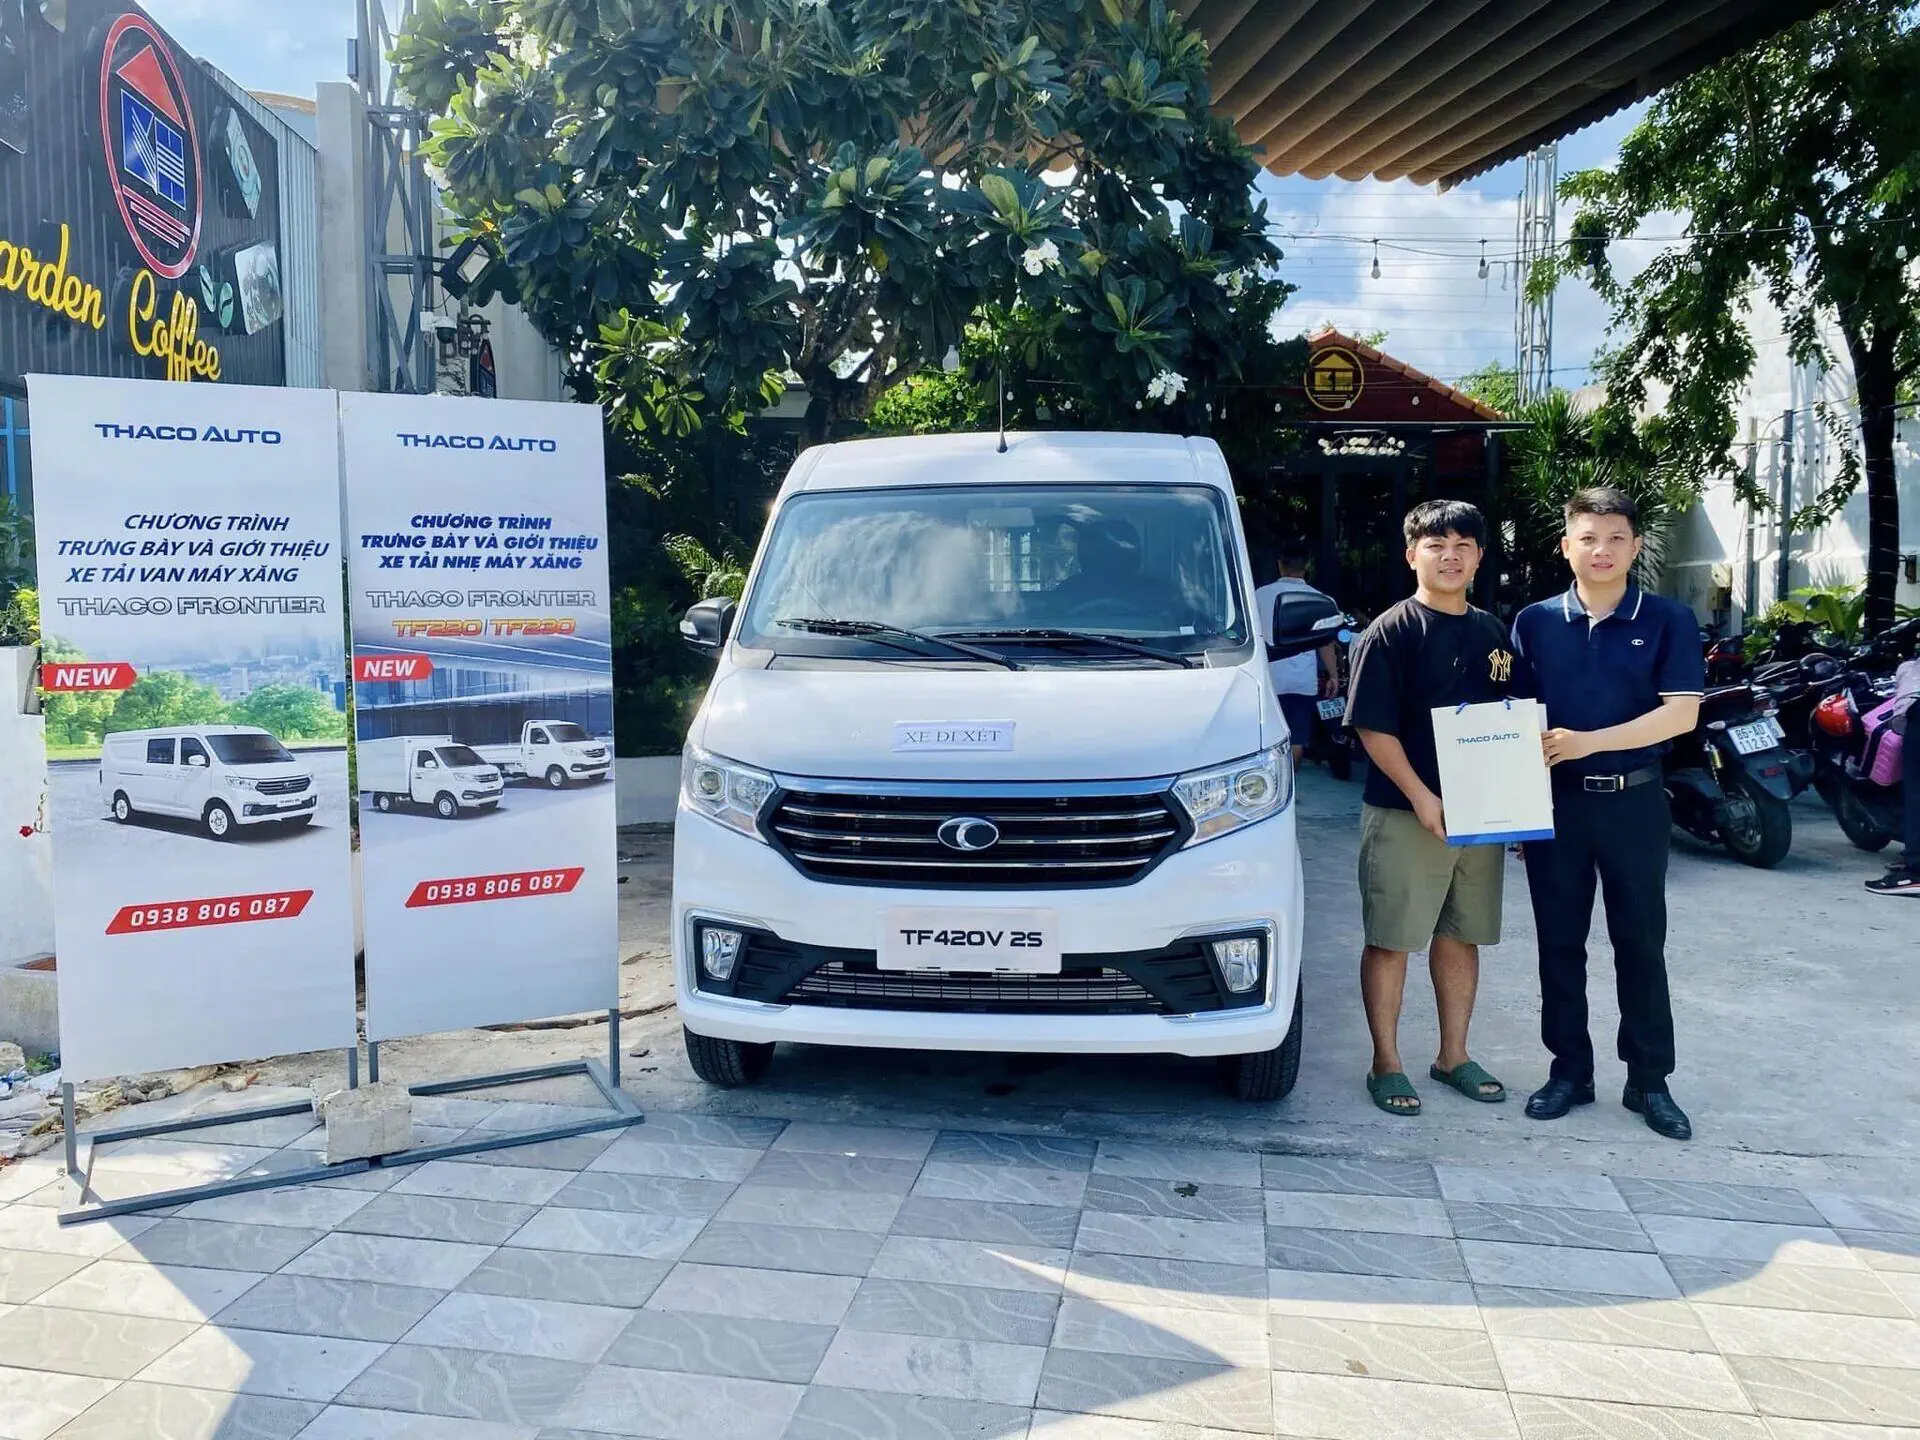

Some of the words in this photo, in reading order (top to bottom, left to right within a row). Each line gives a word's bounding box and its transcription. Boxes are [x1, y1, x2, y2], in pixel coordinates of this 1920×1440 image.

[127, 269, 222, 382] Coffee
[94, 423, 197, 441] THACO
[202, 426, 281, 445] AUTO
[396, 433, 484, 449] THACO
[488, 435, 556, 452] AUTO
[124, 513, 222, 532] CHƯƠNG
[226, 515, 290, 532] TRÌNH
[410, 514, 493, 529] CHƯƠNG
[498, 513, 552, 530] TRÌNH
[57, 540, 136, 556] TRƯNG
[139, 538, 184, 556] BÀY
[187, 538, 214, 557] VÀ
[219, 541, 267, 557] GIỚI
[269, 540, 330, 561] THIỆU
[361, 533, 427, 548] TRƯNG
[431, 532, 470, 549] BÀY
[475, 533, 499, 549] VÀ
[503, 535, 545, 550] GIỚI
[549, 535, 598, 553] THIỆU
[378, 555, 403, 569] XE
[409, 551, 437, 569] TẢI
[443, 556, 480, 573] NHẸ
[484, 555, 527, 570] MÁY
[529, 553, 582, 570] XĂNG
[65, 567, 98, 583] XE
[101, 563, 135, 583] TẢI
[139, 567, 185, 583] VAN
[187, 566, 236, 583] MÁY
[238, 565, 299, 583] XĂNG
[57, 597, 173, 616] THACO
[177, 597, 326, 615] FRONTIER
[366, 590, 465, 608] THACO
[467, 590, 598, 607] FRONTIER
[392, 619, 484, 637] TF220
[489, 618, 577, 636] TF230
[55, 667, 118, 687] NEW
[362, 659, 418, 678] NEW
[904, 730, 931, 743] XE
[960, 728, 1001, 742] XÉT
[1455, 735, 1491, 745] THACO
[1491, 732, 1521, 743] AUTO
[430, 885, 478, 900] 0938
[484, 877, 522, 895] 806
[529, 874, 566, 890] 087
[130, 906, 189, 927] 0938
[197, 902, 240, 920] 806
[249, 897, 291, 915] 087
[900, 929, 1004, 947] TF420V
[1010, 931, 1043, 947] 2S
